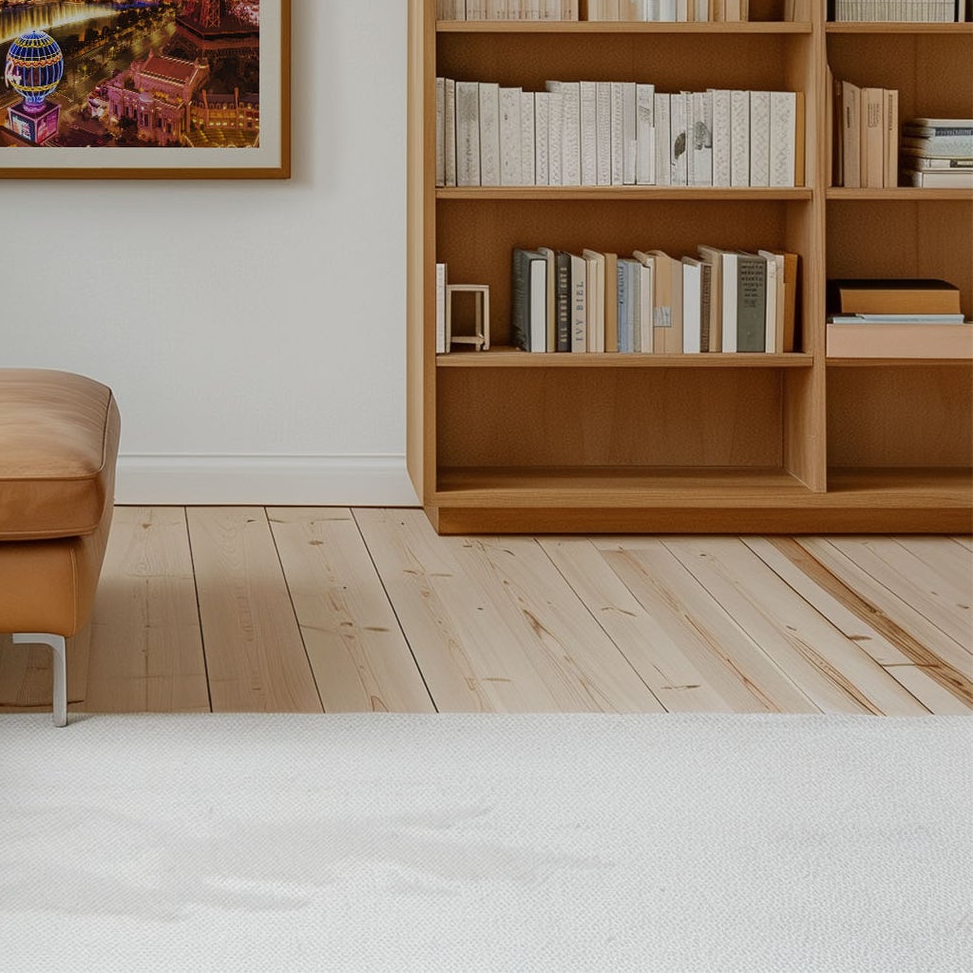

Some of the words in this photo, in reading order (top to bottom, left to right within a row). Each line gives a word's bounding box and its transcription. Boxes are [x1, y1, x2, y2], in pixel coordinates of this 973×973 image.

[576, 281, 584, 311] BIEL
[560, 327, 568, 343] ALL
[576, 319, 584, 341] IVY
